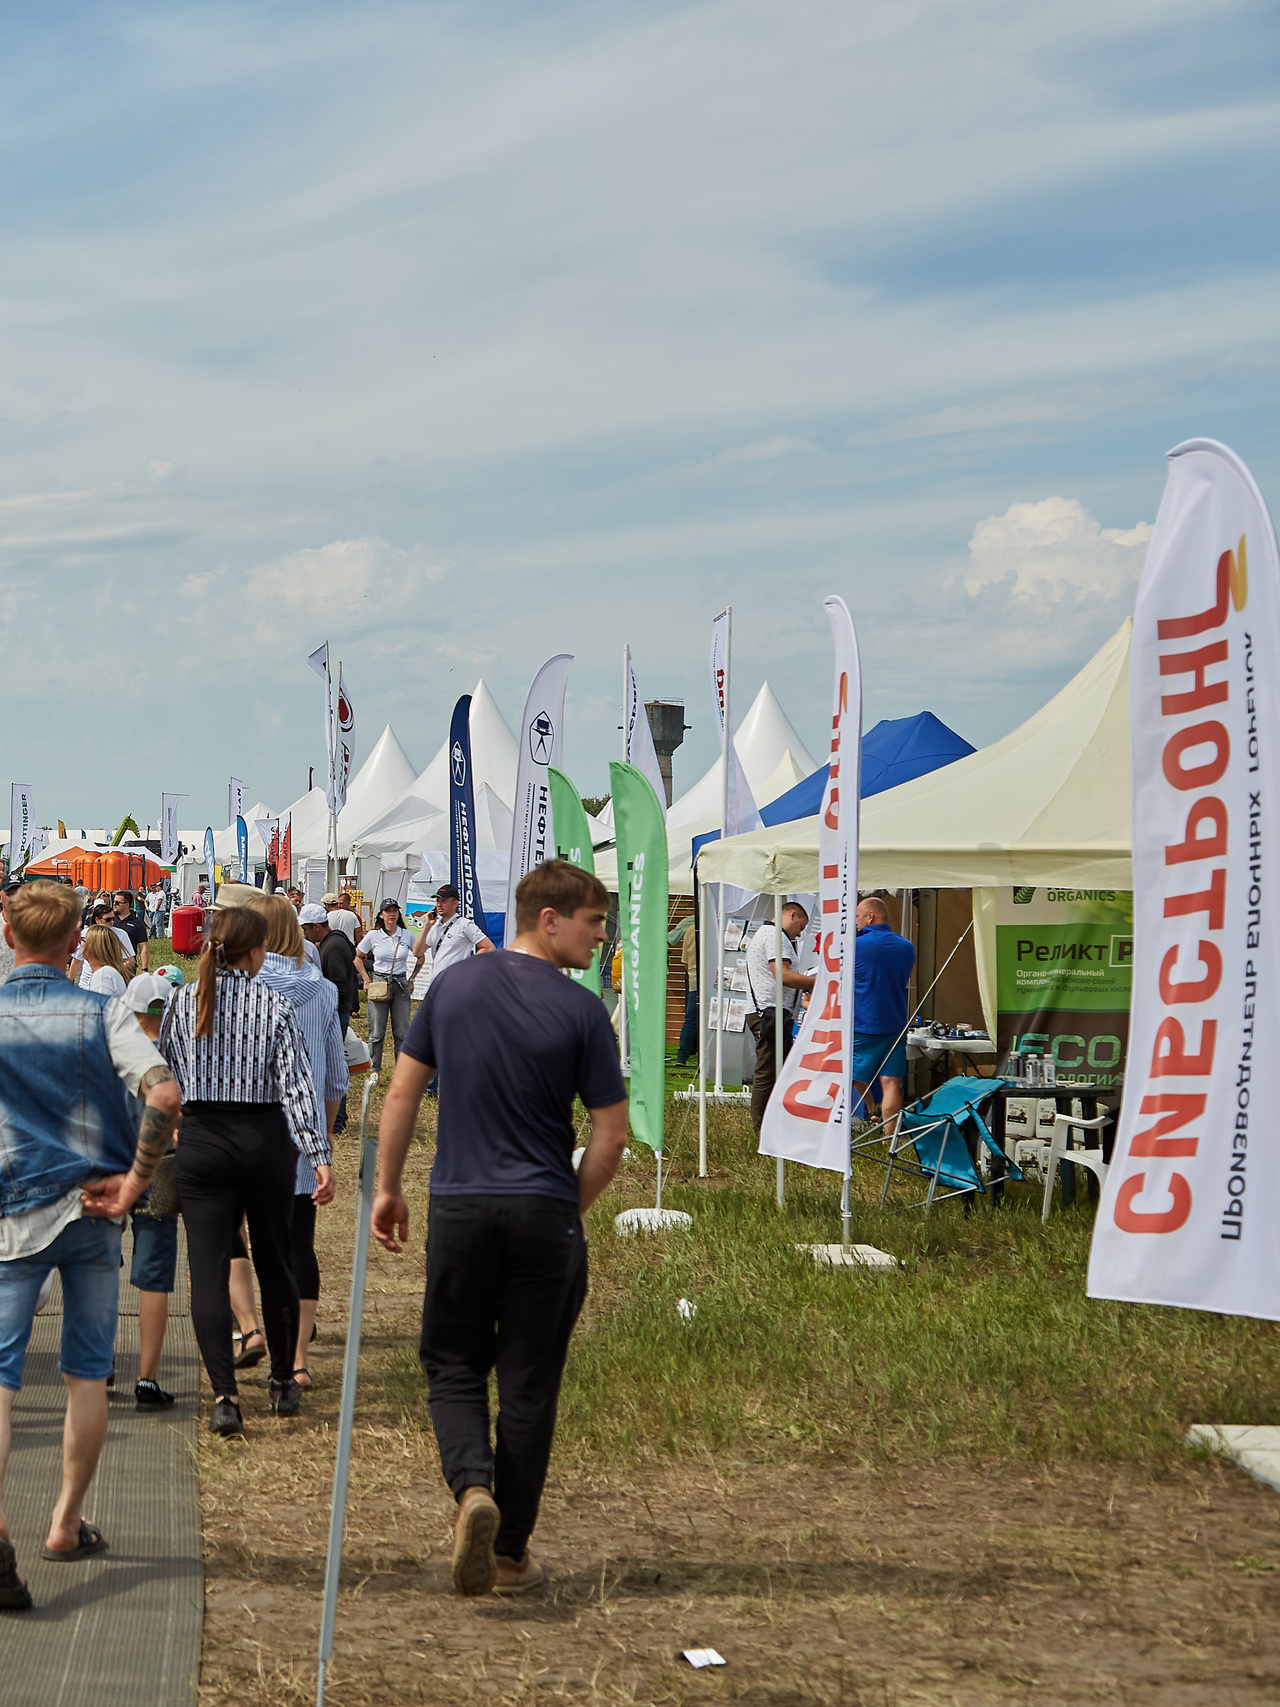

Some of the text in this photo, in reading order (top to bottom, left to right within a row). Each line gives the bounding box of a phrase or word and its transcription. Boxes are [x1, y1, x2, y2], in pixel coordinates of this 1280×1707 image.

[519, 831, 528, 880] ОГРАНИЧЕНН
[1047, 890, 1116, 902] ORGANICS
[1017, 940, 1108, 962] Реликт
